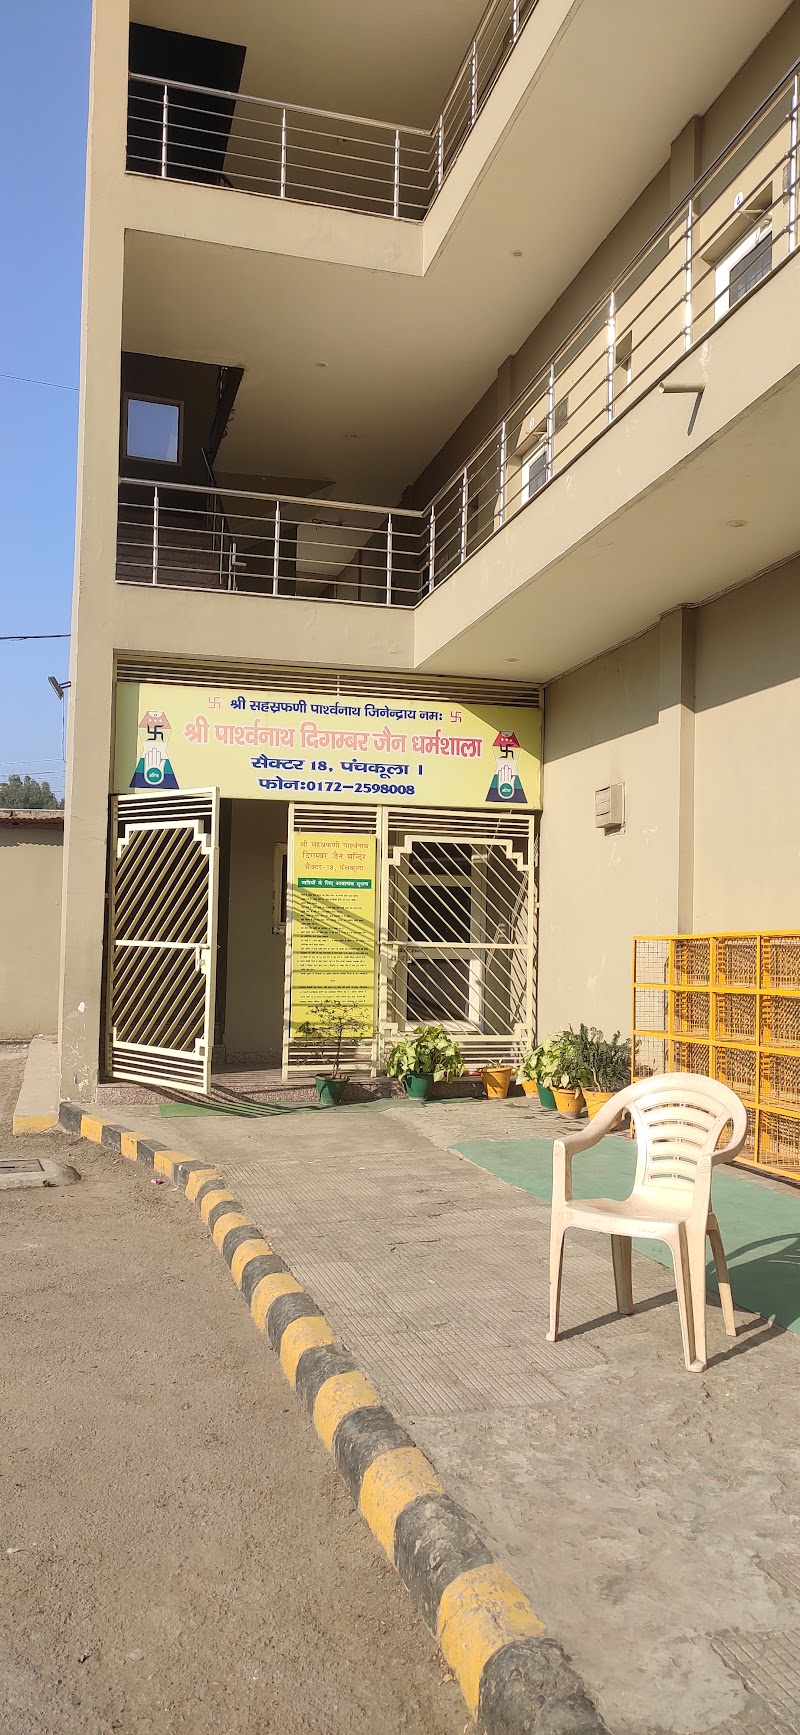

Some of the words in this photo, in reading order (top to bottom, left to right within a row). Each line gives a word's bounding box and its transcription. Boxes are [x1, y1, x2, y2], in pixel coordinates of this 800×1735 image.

[230, 695, 247, 711] श्री
[249, 700, 307, 714] सहस्रफणी
[310, 701, 361, 717] पार्श्वनाथ
[364, 703, 417, 721] जिनेन्द्राय
[184, 715, 210, 743] श्री
[214, 718, 296, 748] पार्श्वनाथ
[300, 721, 370, 752] दिगम्बर
[372, 725, 407, 753] जैन
[411, 728, 483, 758] धर्मशाला
[250, 753, 306, 771] सैक्टर
[310, 760, 333, 773] 18,
[340, 758, 410, 779] पंचकूला
